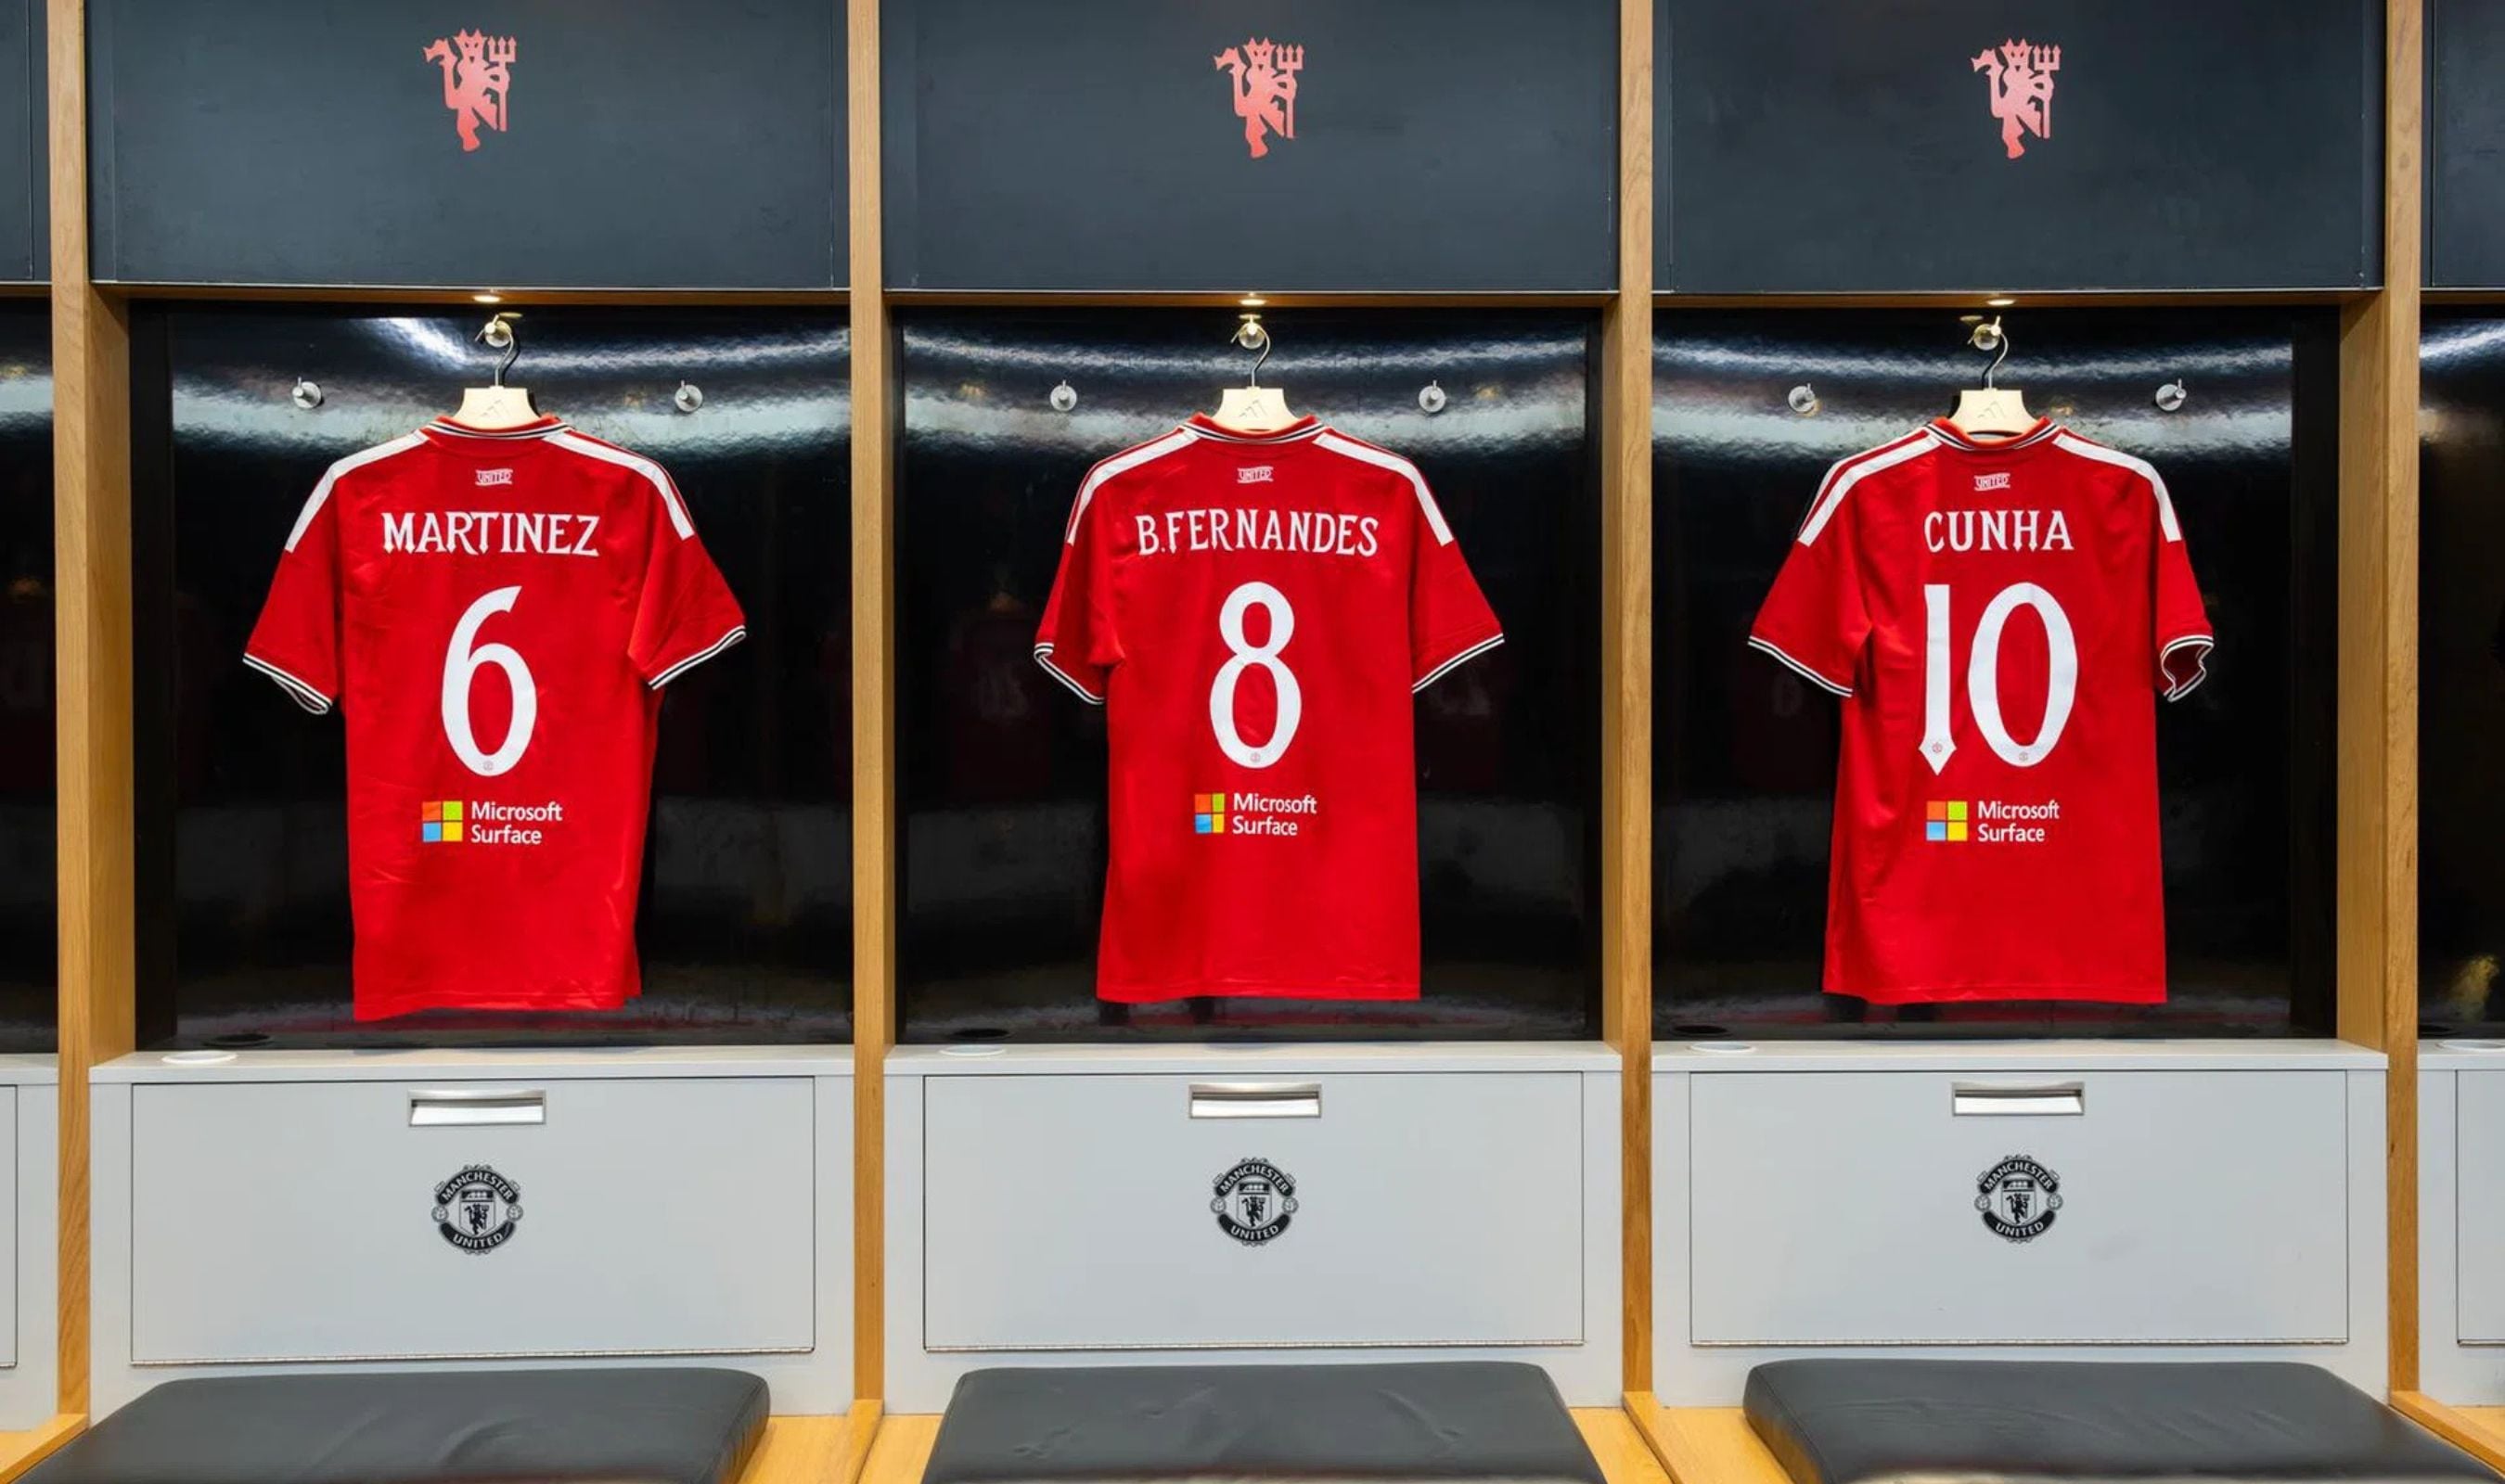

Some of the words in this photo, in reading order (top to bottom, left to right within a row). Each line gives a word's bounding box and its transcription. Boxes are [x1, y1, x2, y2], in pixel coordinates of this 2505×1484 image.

[476, 468, 513, 486] UNITED
[1238, 466, 1274, 483] UNITED
[1974, 473, 2010, 492] UNITED
[381, 511, 600, 556] MARTINEZ
[1135, 508, 1379, 557] B.FERNANDES
[1923, 510, 2075, 553] CUNHA
[441, 585, 537, 777] 6
[1209, 581, 1302, 769] 8
[1919, 582, 2078, 775] 10
[470, 800, 563, 822] Microsoft
[1233, 792, 1317, 814] Microsoft
[1978, 800, 2061, 820] Microsoft
[470, 824, 543, 845] Surface
[1232, 815, 1299, 837] Surface
[1977, 823, 2045, 842] Surface
[441, 1171, 514, 1201] MANCHESTER
[1220, 1164, 1289, 1194] MANCHESTER
[1984, 1160, 2053, 1191] MANCHESTER
[452, 1232, 504, 1248] UNITED
[1230, 1224, 1279, 1240] UNITED
[1995, 1221, 2044, 1237] UNITED
